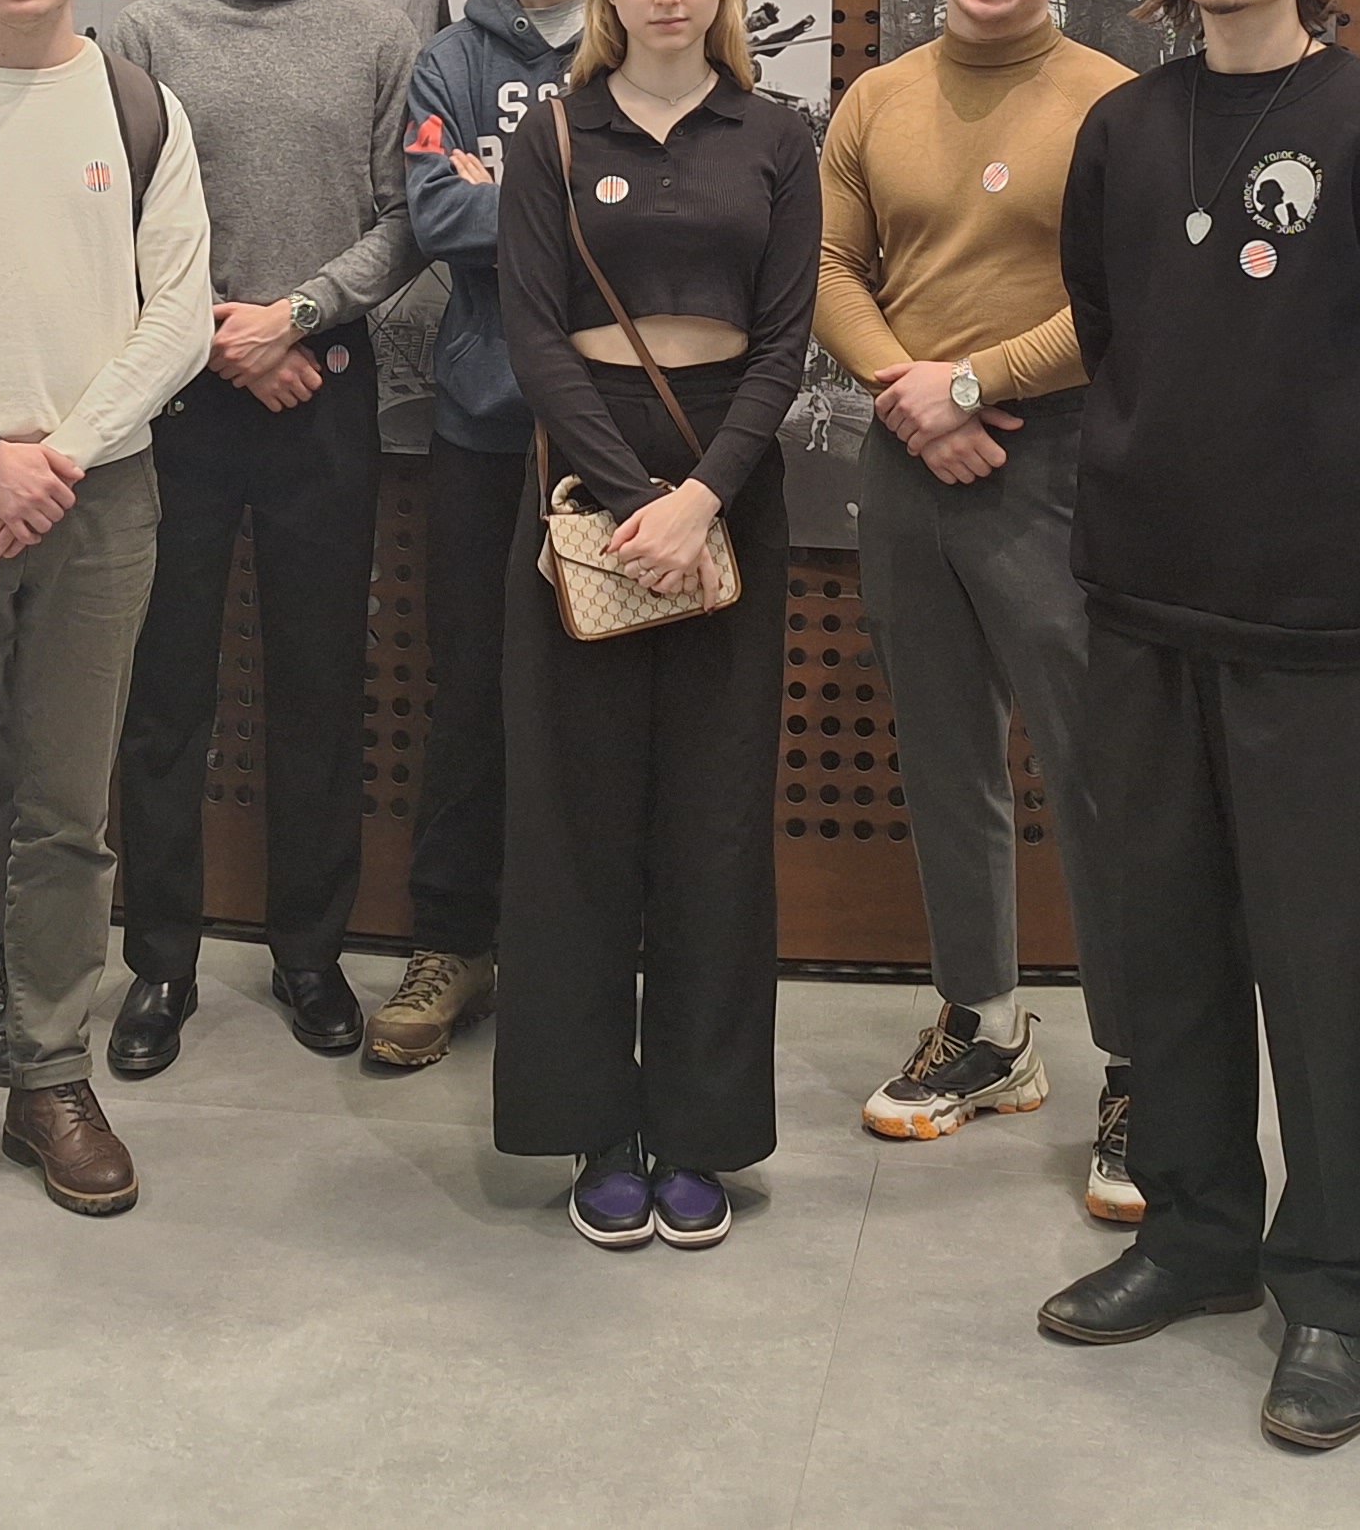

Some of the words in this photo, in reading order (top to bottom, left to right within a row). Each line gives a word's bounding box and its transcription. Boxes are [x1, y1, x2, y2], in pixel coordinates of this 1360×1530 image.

[1264, 150, 1295, 164] ГОЛОС
[1296, 152, 1317, 169] 2024
[1243, 182, 1256, 213] ГОЛОС
